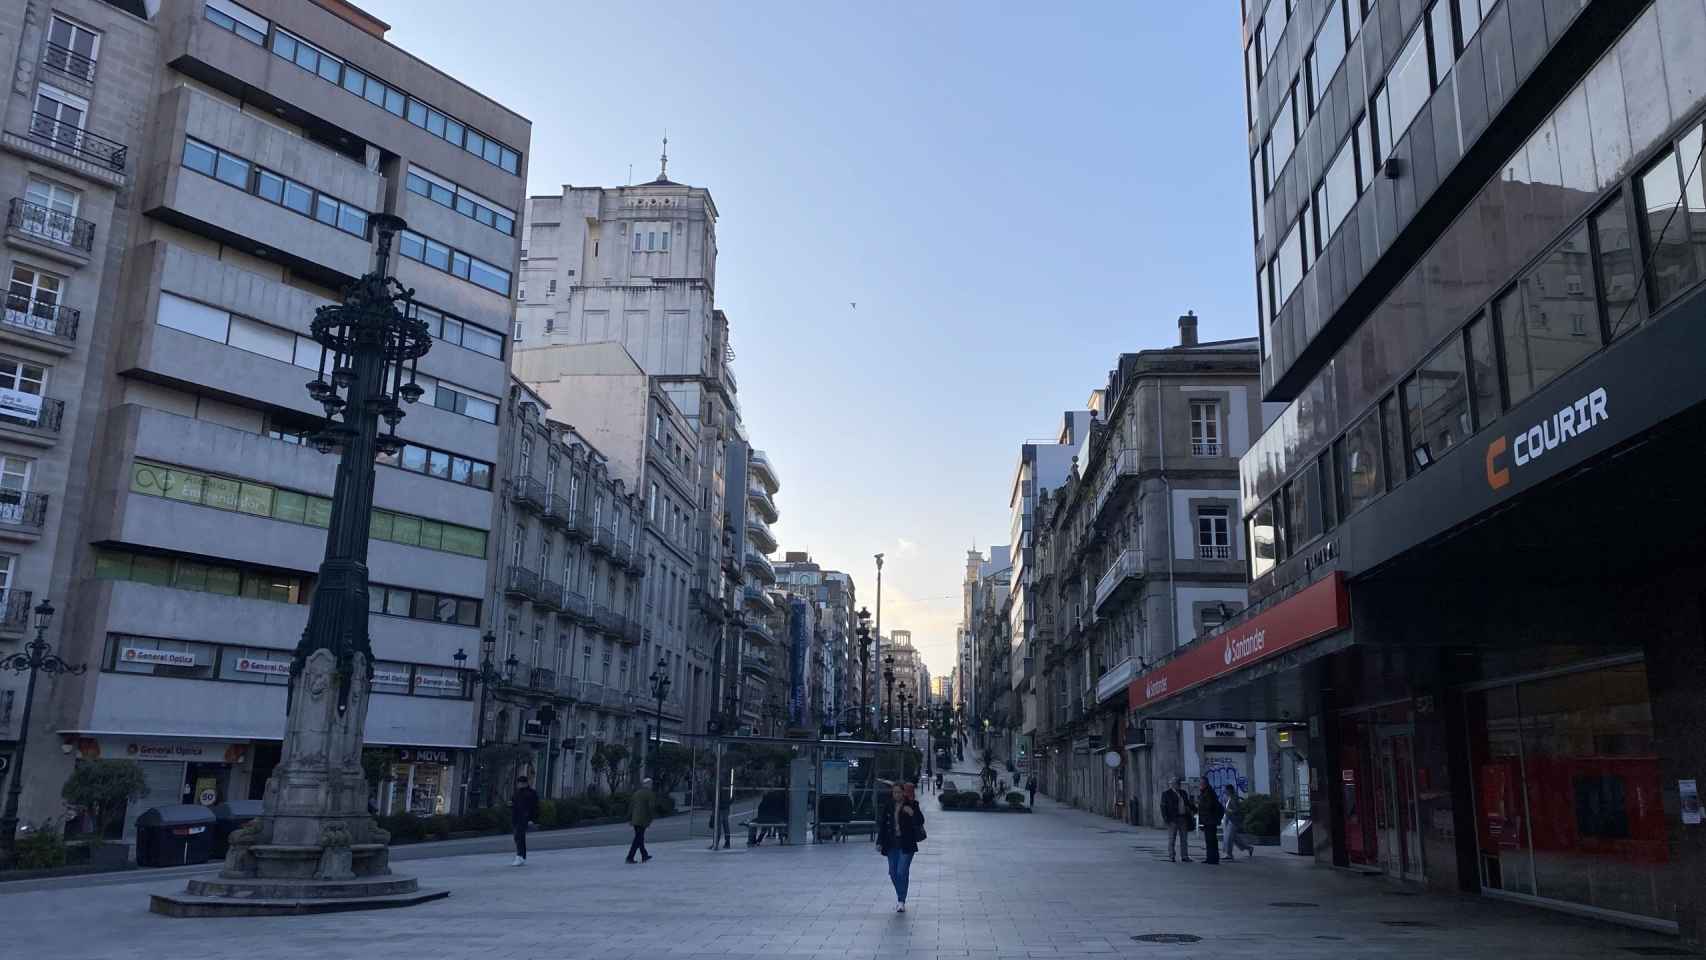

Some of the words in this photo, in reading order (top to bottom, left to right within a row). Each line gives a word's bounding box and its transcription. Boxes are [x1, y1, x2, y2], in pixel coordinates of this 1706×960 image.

[1513, 387, 1608, 467] COURIR
[1231, 628, 1265, 662] Santander
[138, 651, 168, 663] General
[251, 662, 277, 672] General
[1150, 676, 1167, 697] Santander
[1205, 722, 1245, 731] ESTRELLA
[140, 744, 174, 754] General
